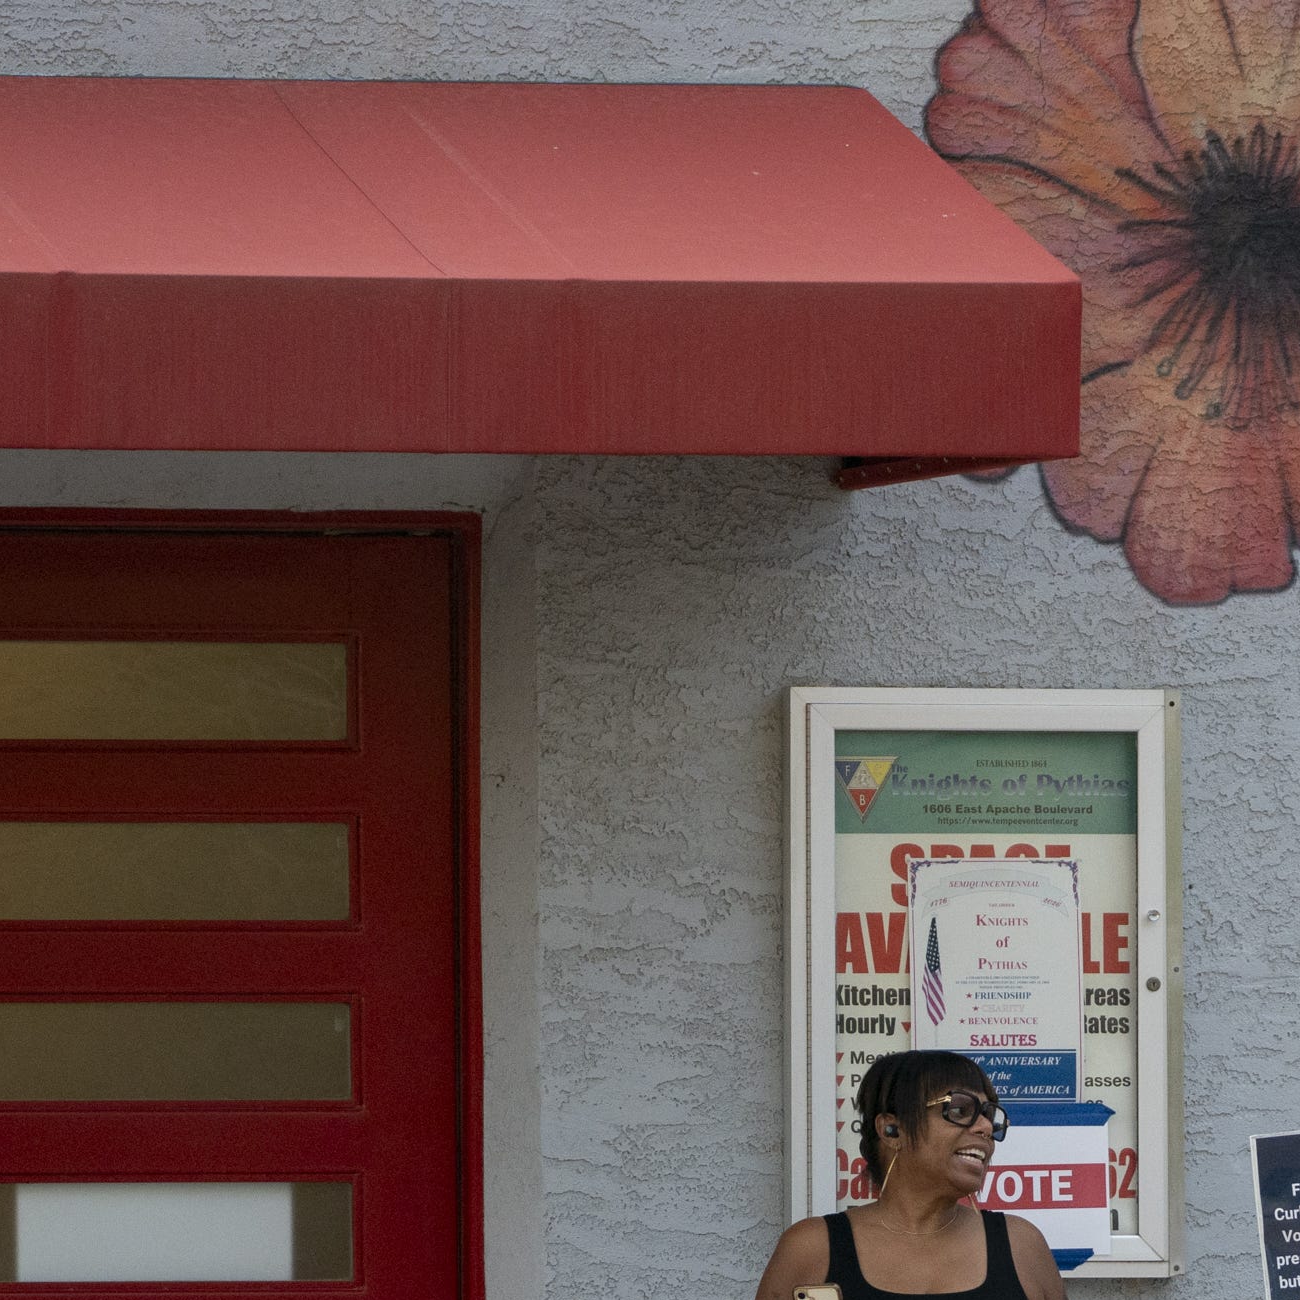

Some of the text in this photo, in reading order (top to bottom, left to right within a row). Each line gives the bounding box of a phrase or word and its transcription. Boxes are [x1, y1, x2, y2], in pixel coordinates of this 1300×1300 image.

[976, 759, 1028, 768] ESTABLISHED
[891, 773, 1129, 801] Knights of Pythias
[922, 804, 1093, 816] 1606 East Apache Boulevard
[949, 880, 1040, 889] SEMIQUINCENTENNIAL
[995, 936, 1011, 949] of
[974, 992, 1032, 1000] FRIENDSHIP
[1083, 986, 1131, 1006] reas
[968, 1017, 1039, 1025] BENEVOLENCE
[970, 1034, 1037, 1047] SALUTES
[987, 1056, 1062, 1066] ANNIVERSARY
[997, 1071, 1012, 1080] the
[1084, 1076, 1132, 1087] asses
[1010, 1085, 1022, 1096] of
[1020, 1085, 1070, 1095] AMERICA
[975, 1169, 1074, 1203] VOTE
